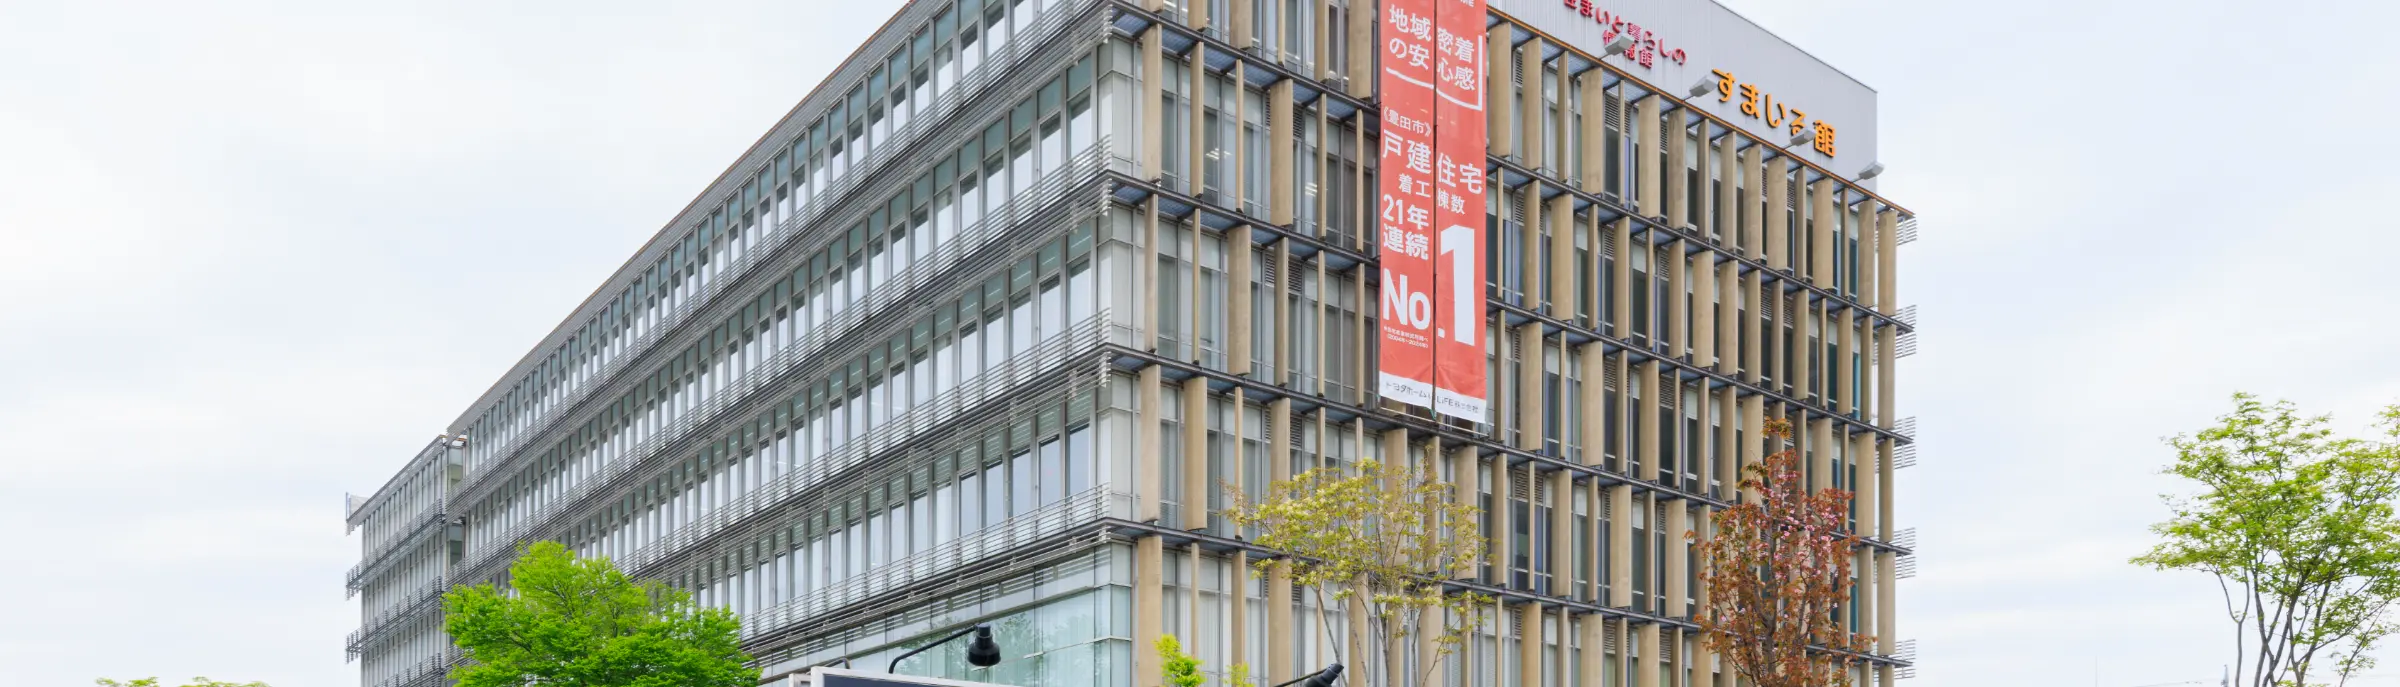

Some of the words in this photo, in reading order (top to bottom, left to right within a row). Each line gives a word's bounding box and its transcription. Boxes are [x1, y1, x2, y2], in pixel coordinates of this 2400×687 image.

[1712, 68, 1836, 158] すまいる館
[1383, 193, 1429, 230] 21年
